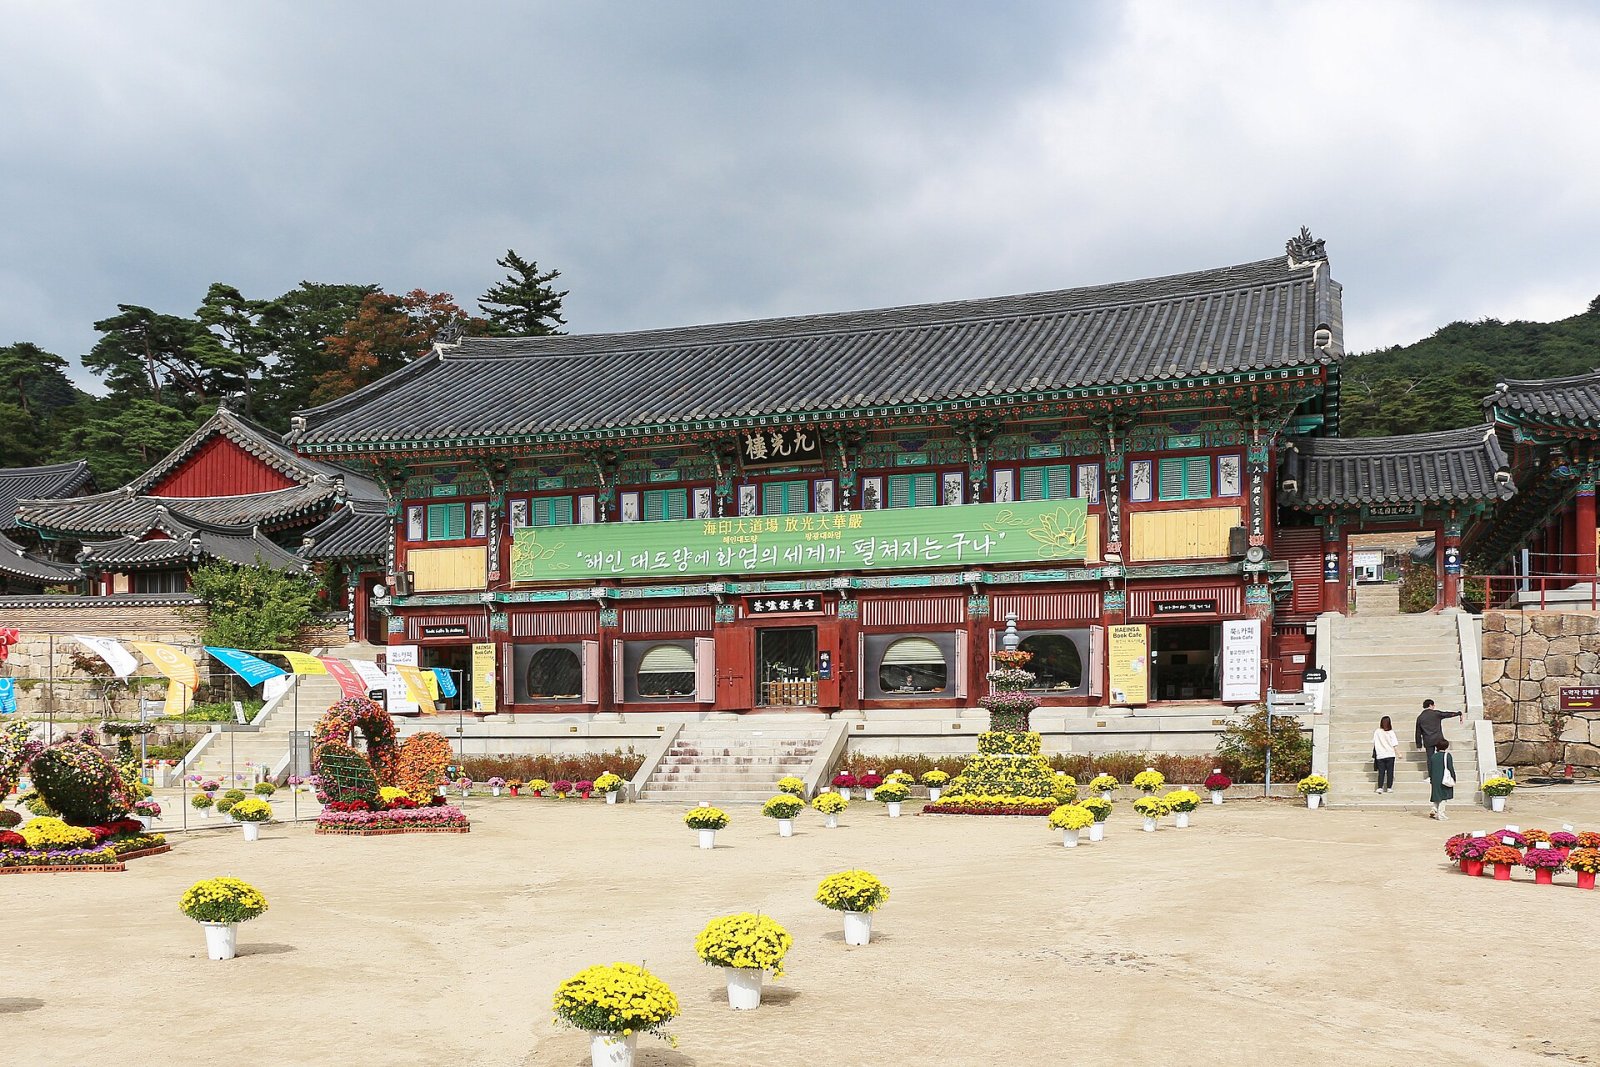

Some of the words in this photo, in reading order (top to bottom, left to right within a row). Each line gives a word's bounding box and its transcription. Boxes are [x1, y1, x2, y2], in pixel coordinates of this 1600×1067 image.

[703, 518, 779, 536] 海印大道場
[784, 513, 863, 532] 放光大華嚴
[722, 535, 758, 544] 해인대도량
[630, 546, 710, 573] 대도량에
[716, 544, 779, 570] 화엄의
[783, 541, 846, 566] 세계가
